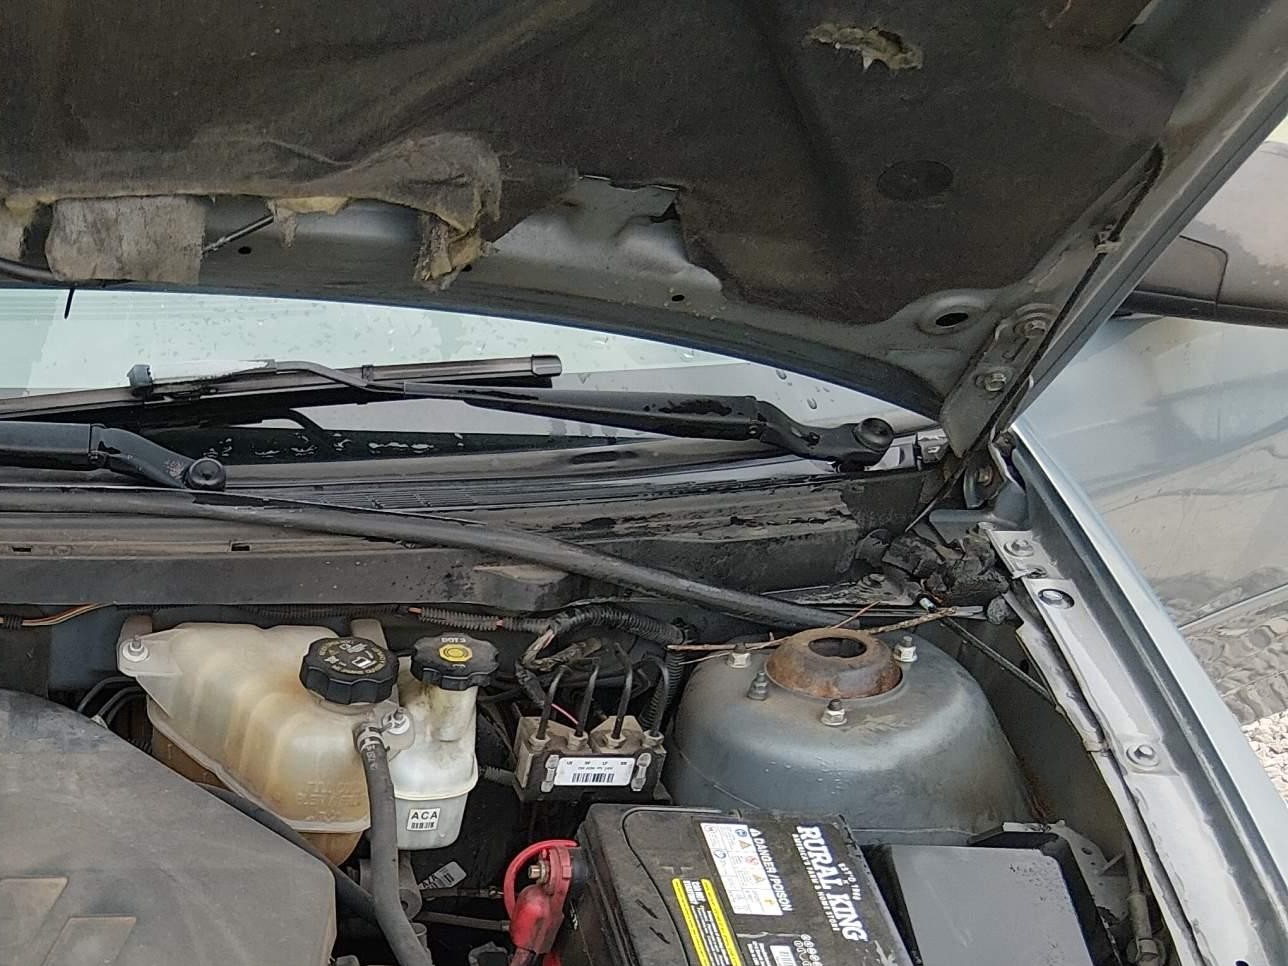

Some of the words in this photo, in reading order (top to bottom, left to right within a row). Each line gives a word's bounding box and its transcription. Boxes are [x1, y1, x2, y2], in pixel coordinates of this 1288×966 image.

[410, 811, 438, 820] ACA
[796, 825, 844, 890] RURAL
[825, 893, 869, 942] KING
